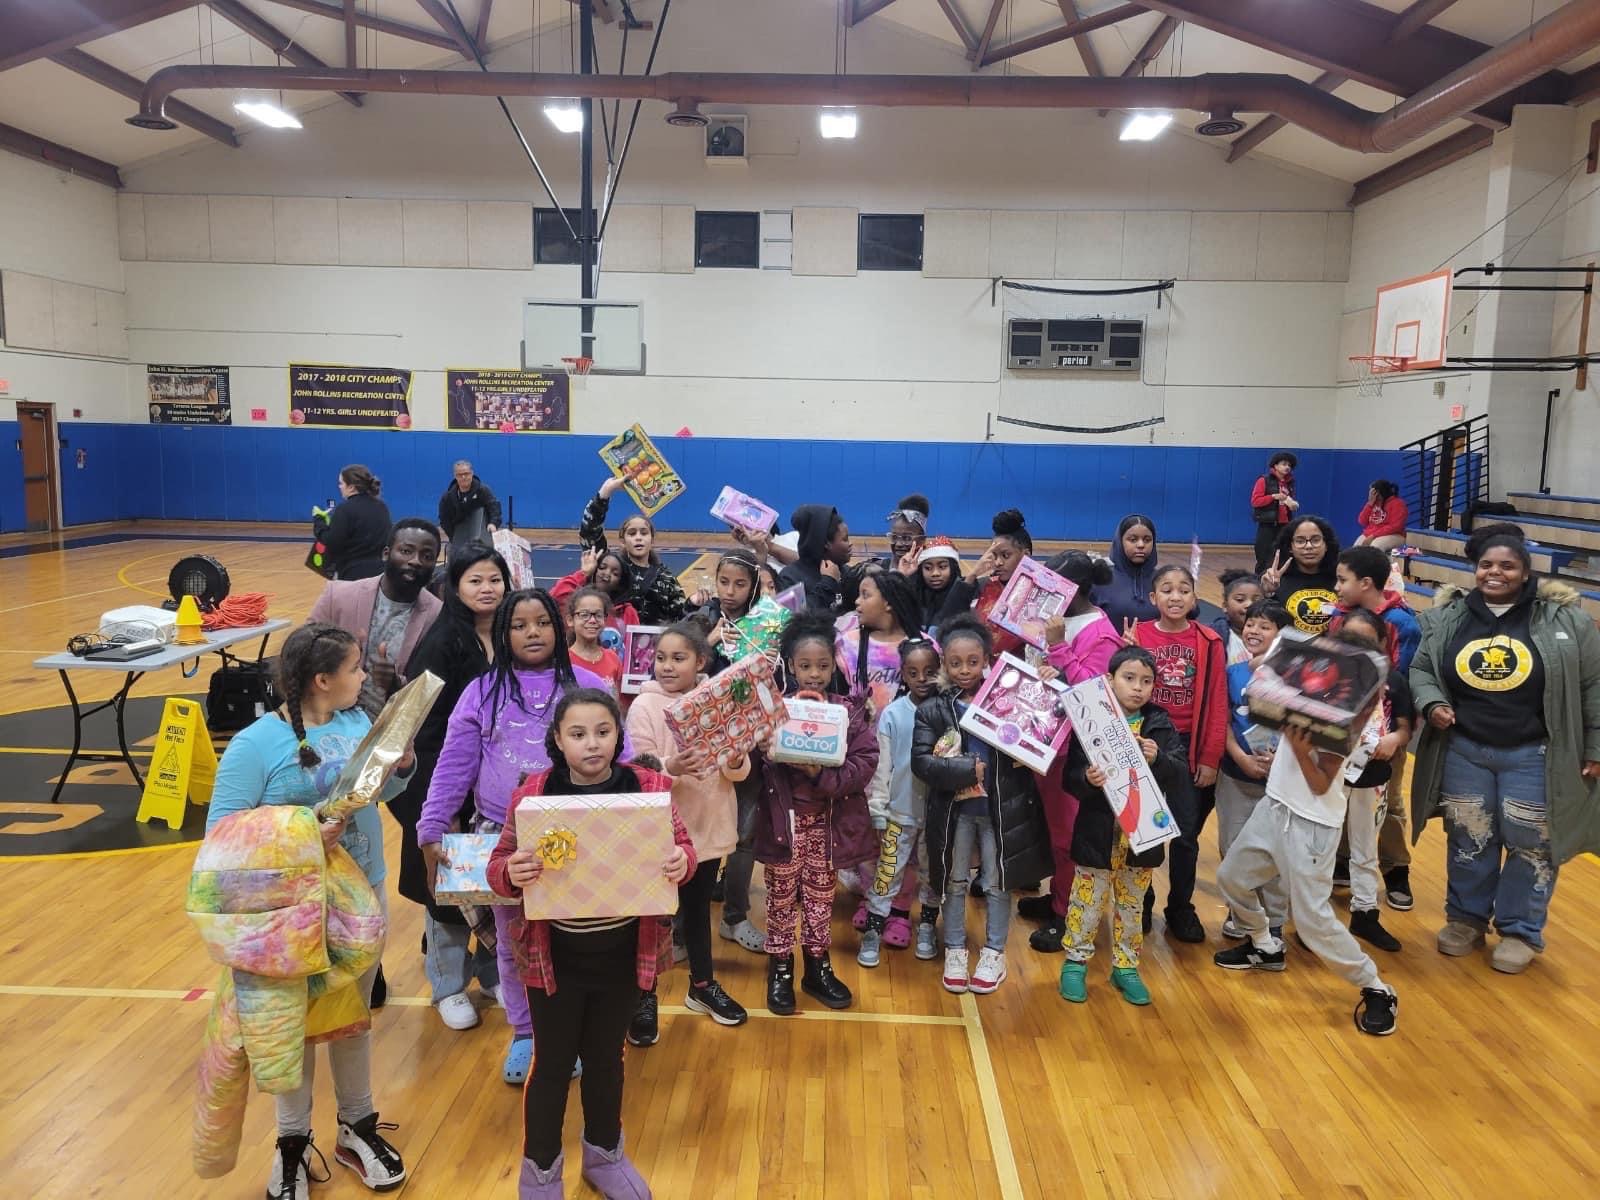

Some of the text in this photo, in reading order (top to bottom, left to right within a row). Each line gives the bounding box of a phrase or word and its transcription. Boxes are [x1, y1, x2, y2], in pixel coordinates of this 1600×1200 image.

[1062, 356, 1088, 367] period
[298, 373, 319, 381] 2017
[324, 374, 346, 382] 2018
[347, 375, 367, 383] CITY
[367, 376, 402, 384] CHAMPS
[312, 390, 341, 398] ROLLINS
[342, 391, 384, 399] RECREATION
[303, 407, 322, 415] 11-12
